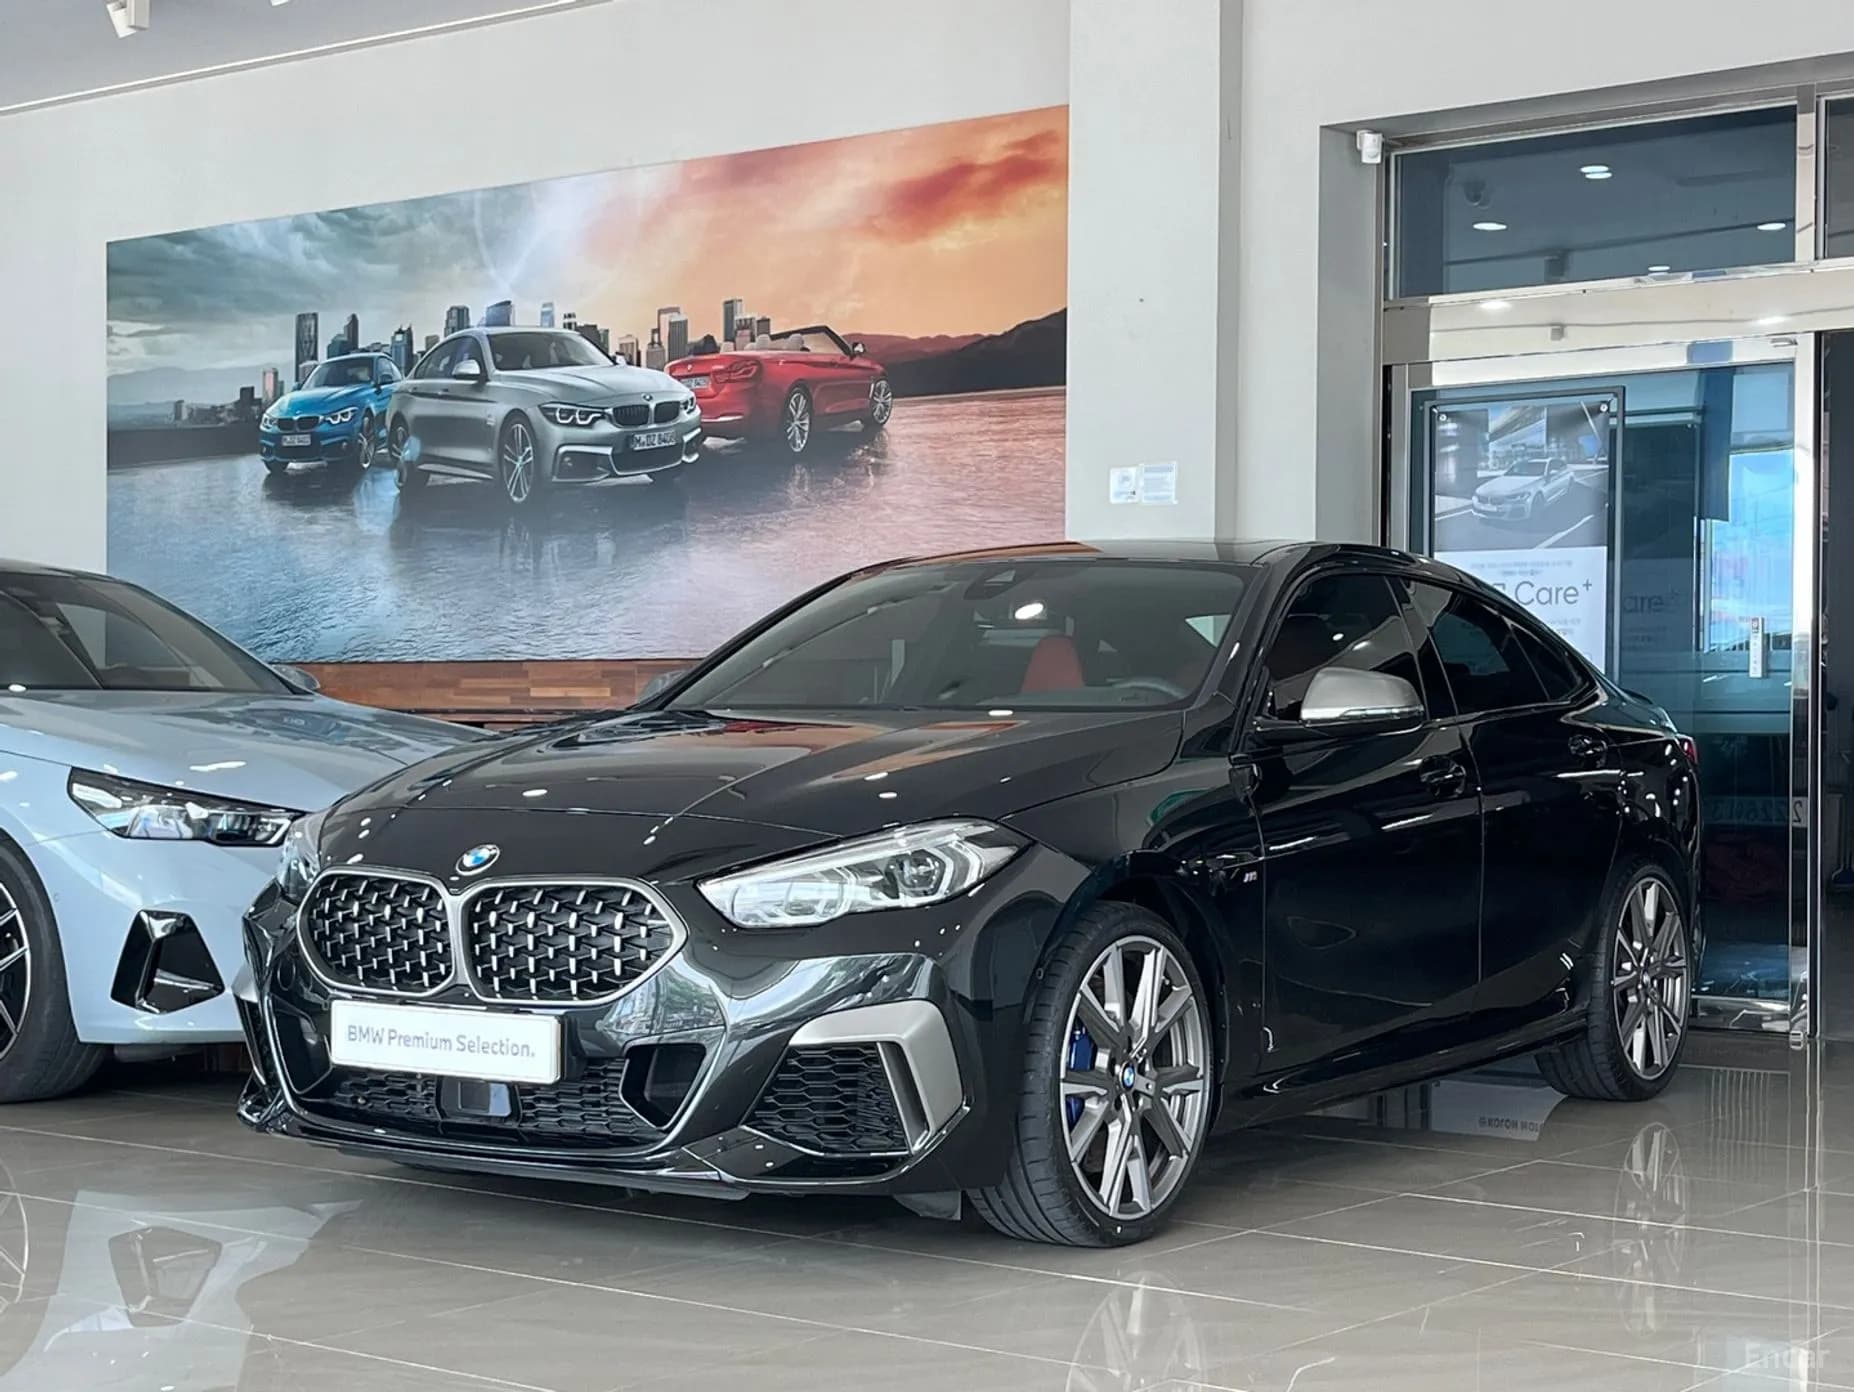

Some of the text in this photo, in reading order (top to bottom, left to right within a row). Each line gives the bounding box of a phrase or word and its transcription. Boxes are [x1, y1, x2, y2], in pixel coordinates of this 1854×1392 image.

[347, 1024, 536, 1058] BMW Premium Selection.
